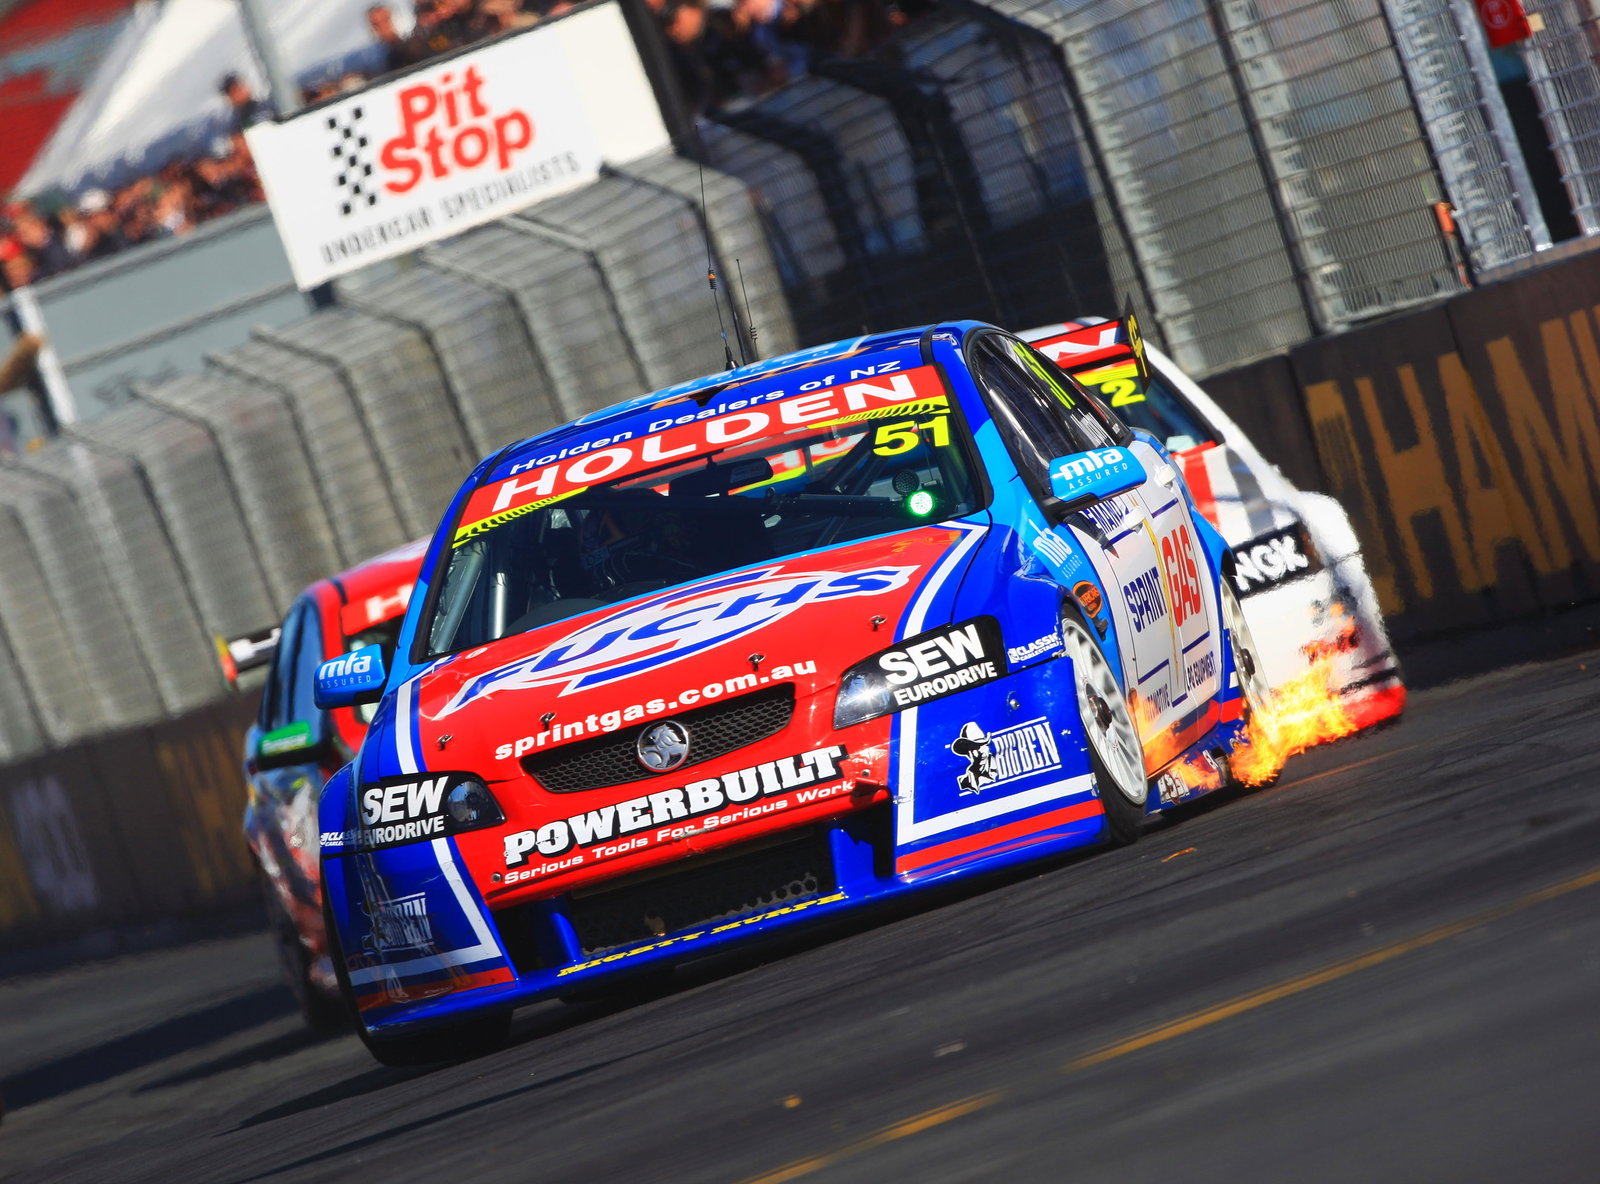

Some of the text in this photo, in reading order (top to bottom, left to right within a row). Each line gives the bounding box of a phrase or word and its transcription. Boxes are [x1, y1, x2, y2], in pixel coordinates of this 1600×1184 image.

[398, 65, 488, 146] Pit
[380, 109, 534, 195] Stop
[320, 151, 581, 265] UNDERCAR SPECIALISTS
[509, 429, 633, 475] Holden
[649, 391, 785, 432] Dealers
[805, 374, 836, 390] of
[850, 360, 901, 380] NZ
[1100, 378, 1146, 407] 2
[491, 374, 917, 512] HOLDEN
[872, 416, 951, 457] 51
[1069, 463, 1128, 490] ASSURED
[1123, 524, 1200, 633] SPRINT GAS
[1235, 536, 1309, 590] NGK
[433, 564, 920, 719] FUCHS
[879, 624, 987, 687] SEW
[320, 675, 371, 688] ASSURED
[494, 660, 817, 759] sprintgas.com.au
[894, 661, 998, 706] EURODRIVE
[362, 775, 449, 826] SEW
[364, 815, 445, 848] EURODRIVE
[504, 744, 846, 866] POWERBUILT
[504, 781, 853, 885] Serious Tools For Serious Work
[557, 931, 705, 977] MIGHTY
